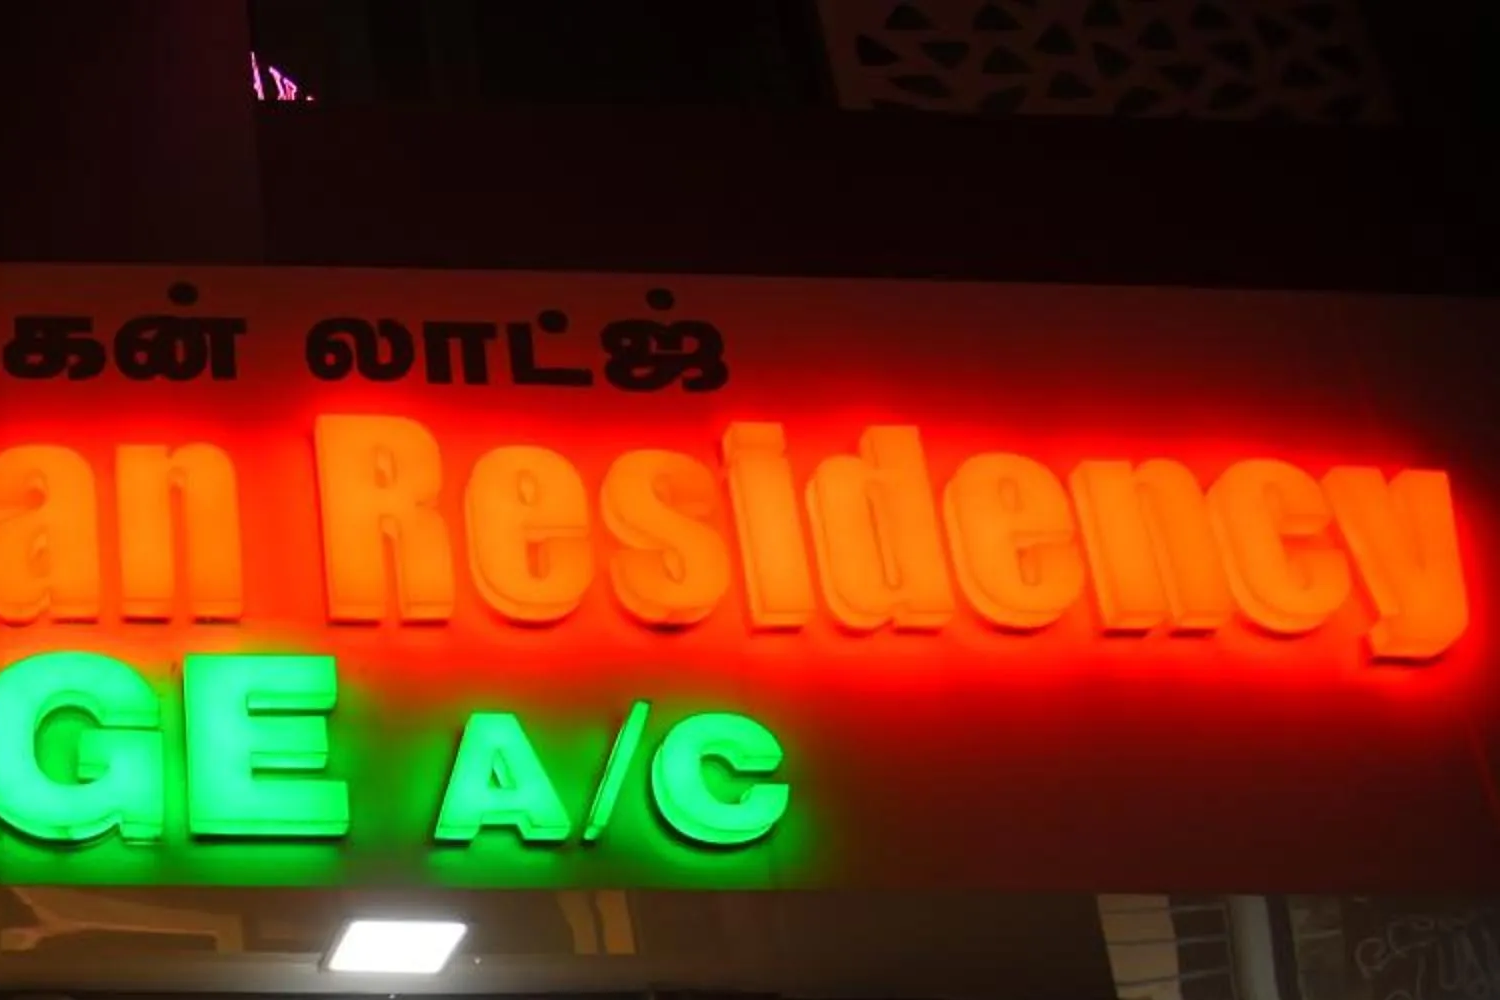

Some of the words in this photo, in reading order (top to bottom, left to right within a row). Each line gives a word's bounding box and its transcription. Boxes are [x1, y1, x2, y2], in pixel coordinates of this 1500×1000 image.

[306, 289, 728, 392] லாட்ஜ்
[312, 414, 1470, 660] Residency
[434, 701, 790, 846] A/C
